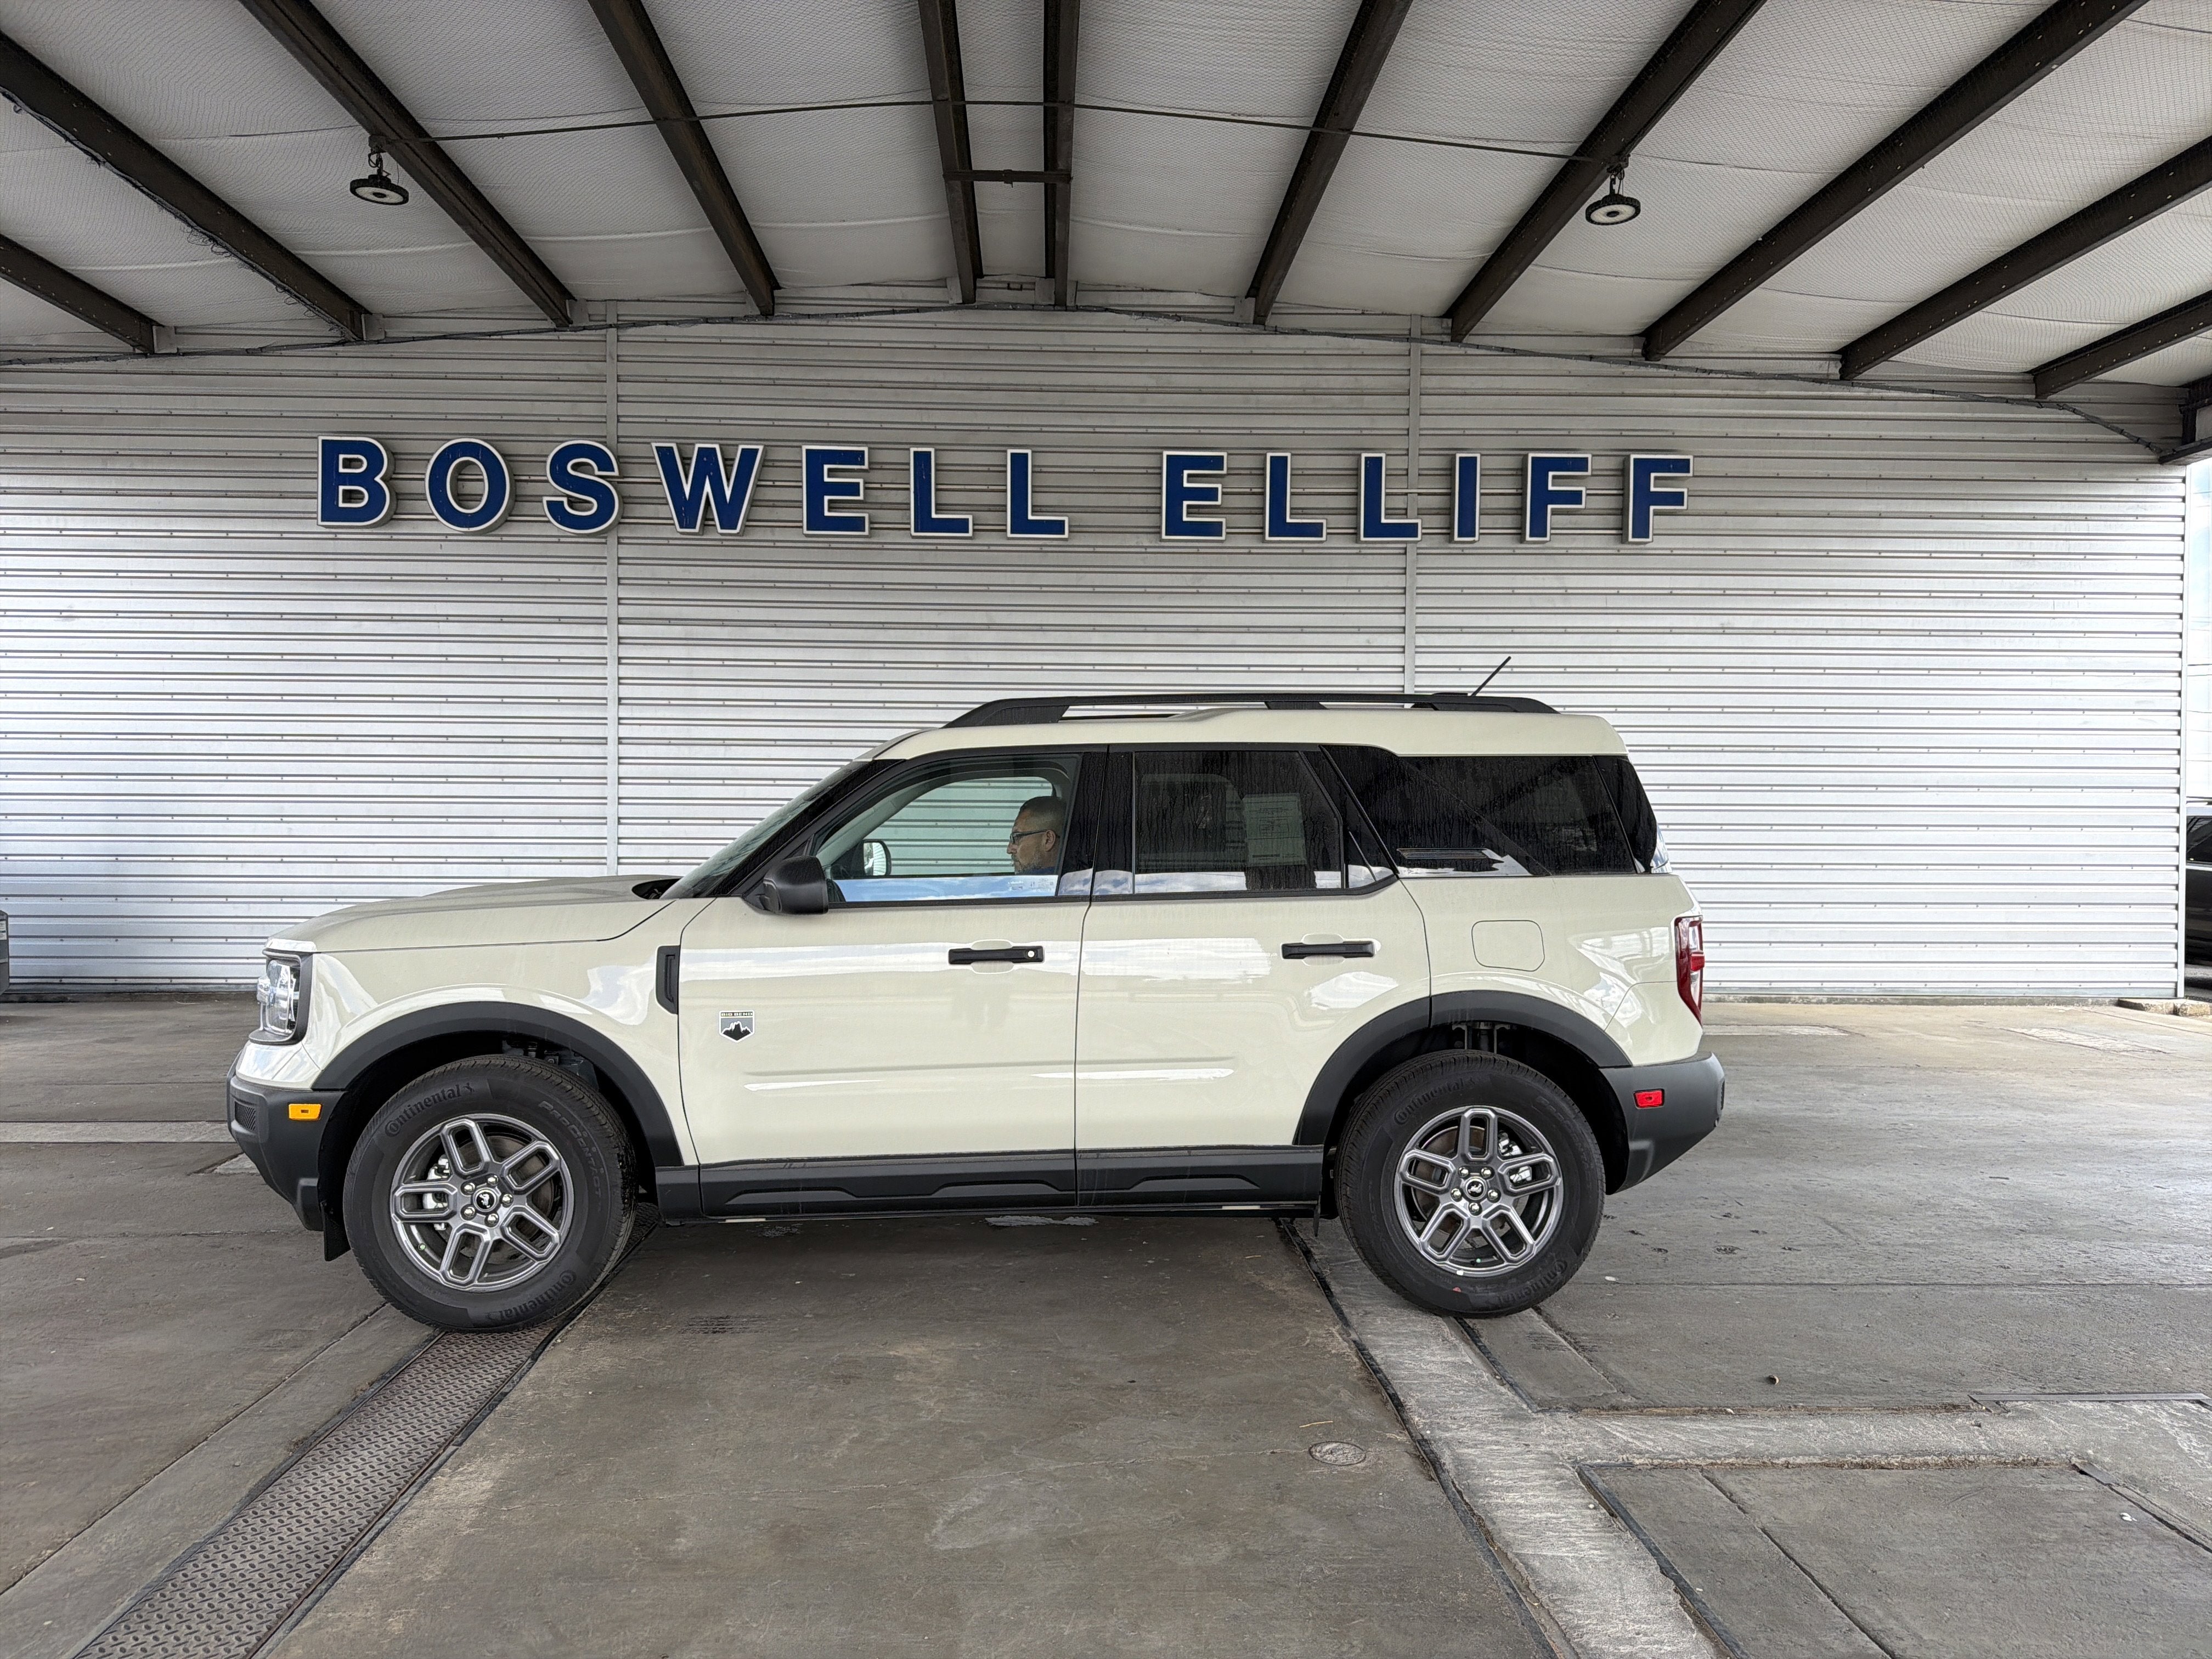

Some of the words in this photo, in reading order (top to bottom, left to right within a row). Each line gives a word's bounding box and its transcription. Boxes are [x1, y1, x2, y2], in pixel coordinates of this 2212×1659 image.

[318, 436, 1069, 539] BOSWELL
[1161, 450, 1694, 542] ELLIFF
[385, 1084, 461, 1137] Continental
